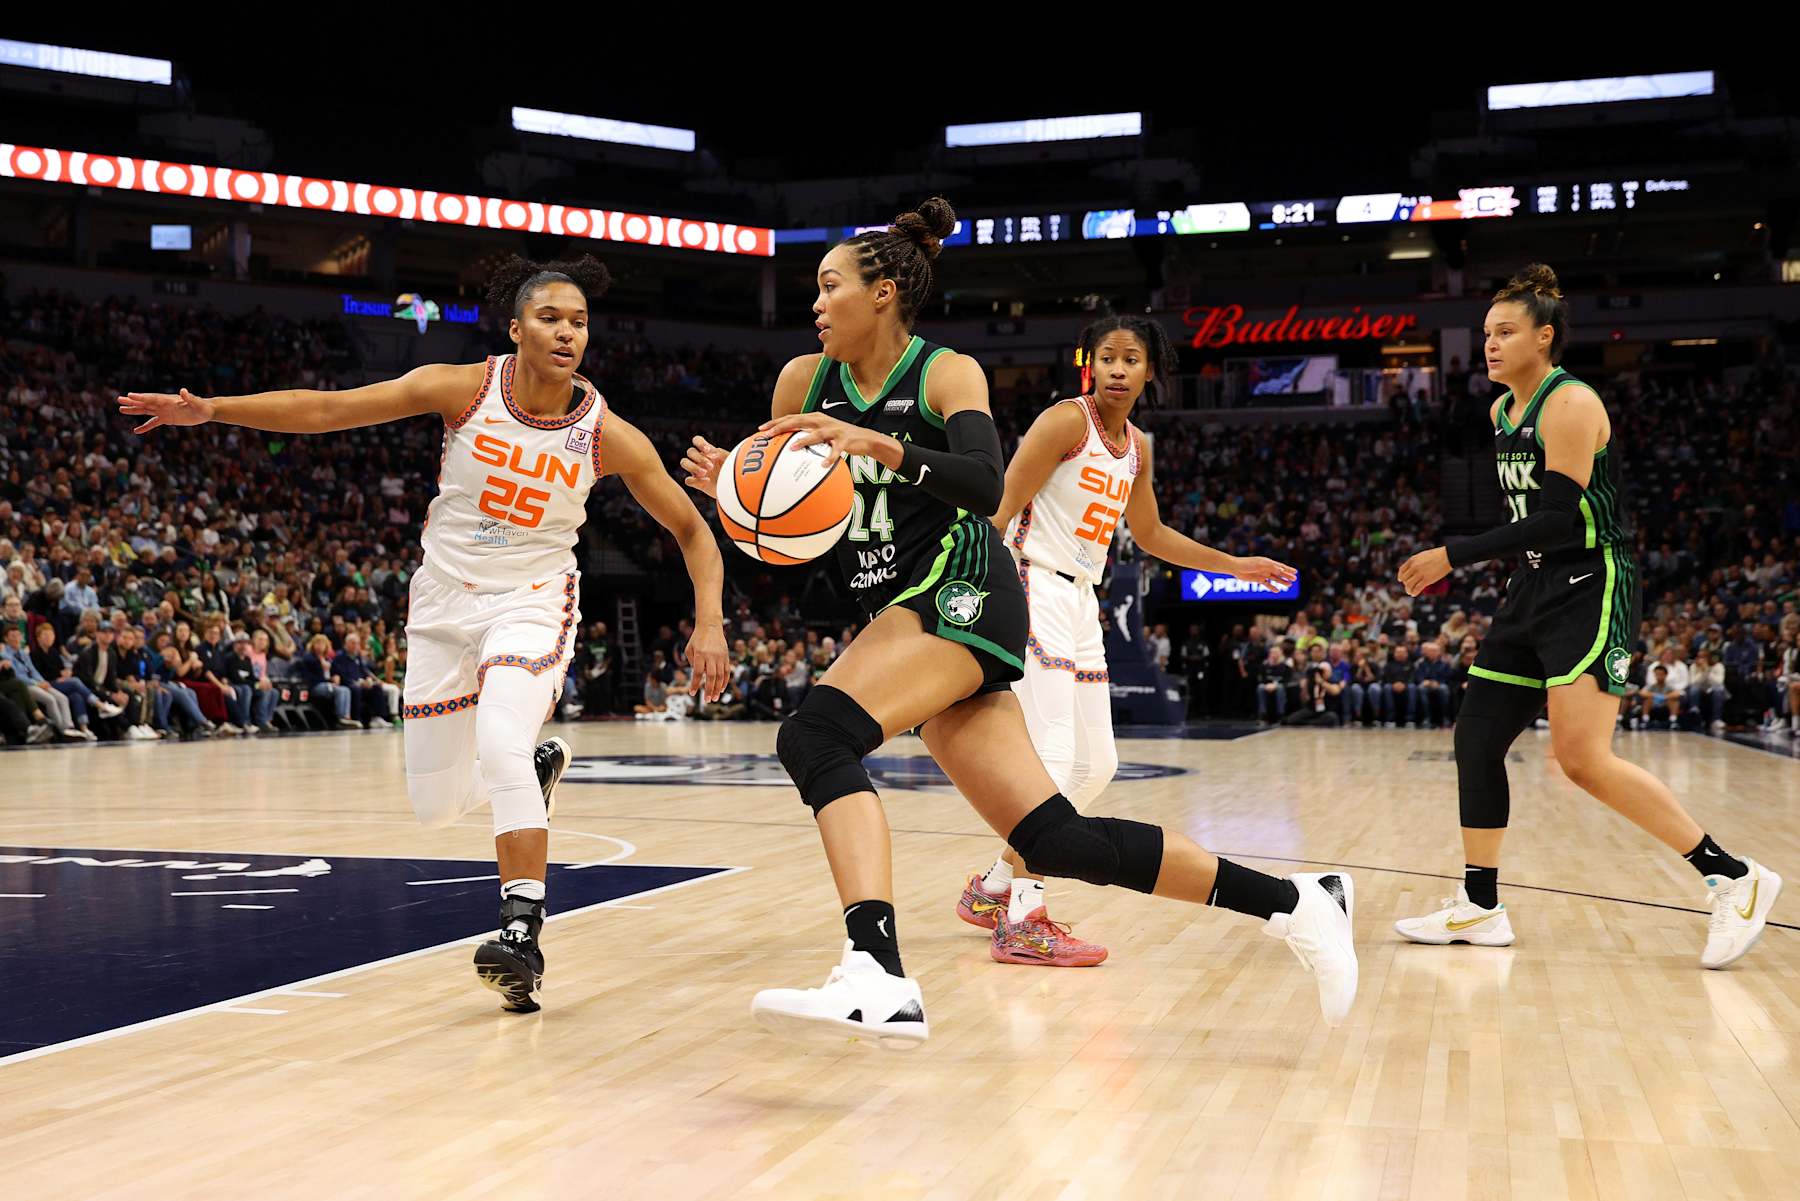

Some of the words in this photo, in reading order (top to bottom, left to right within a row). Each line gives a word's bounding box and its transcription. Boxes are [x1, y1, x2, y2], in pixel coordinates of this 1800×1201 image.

[1272, 202, 1315, 225] 8:21
[1183, 304, 1417, 348] Budweiser
[472, 434, 581, 489] SUN
[479, 475, 551, 528] 25
[848, 488, 897, 542] 24
[1074, 502, 1121, 546] 52
